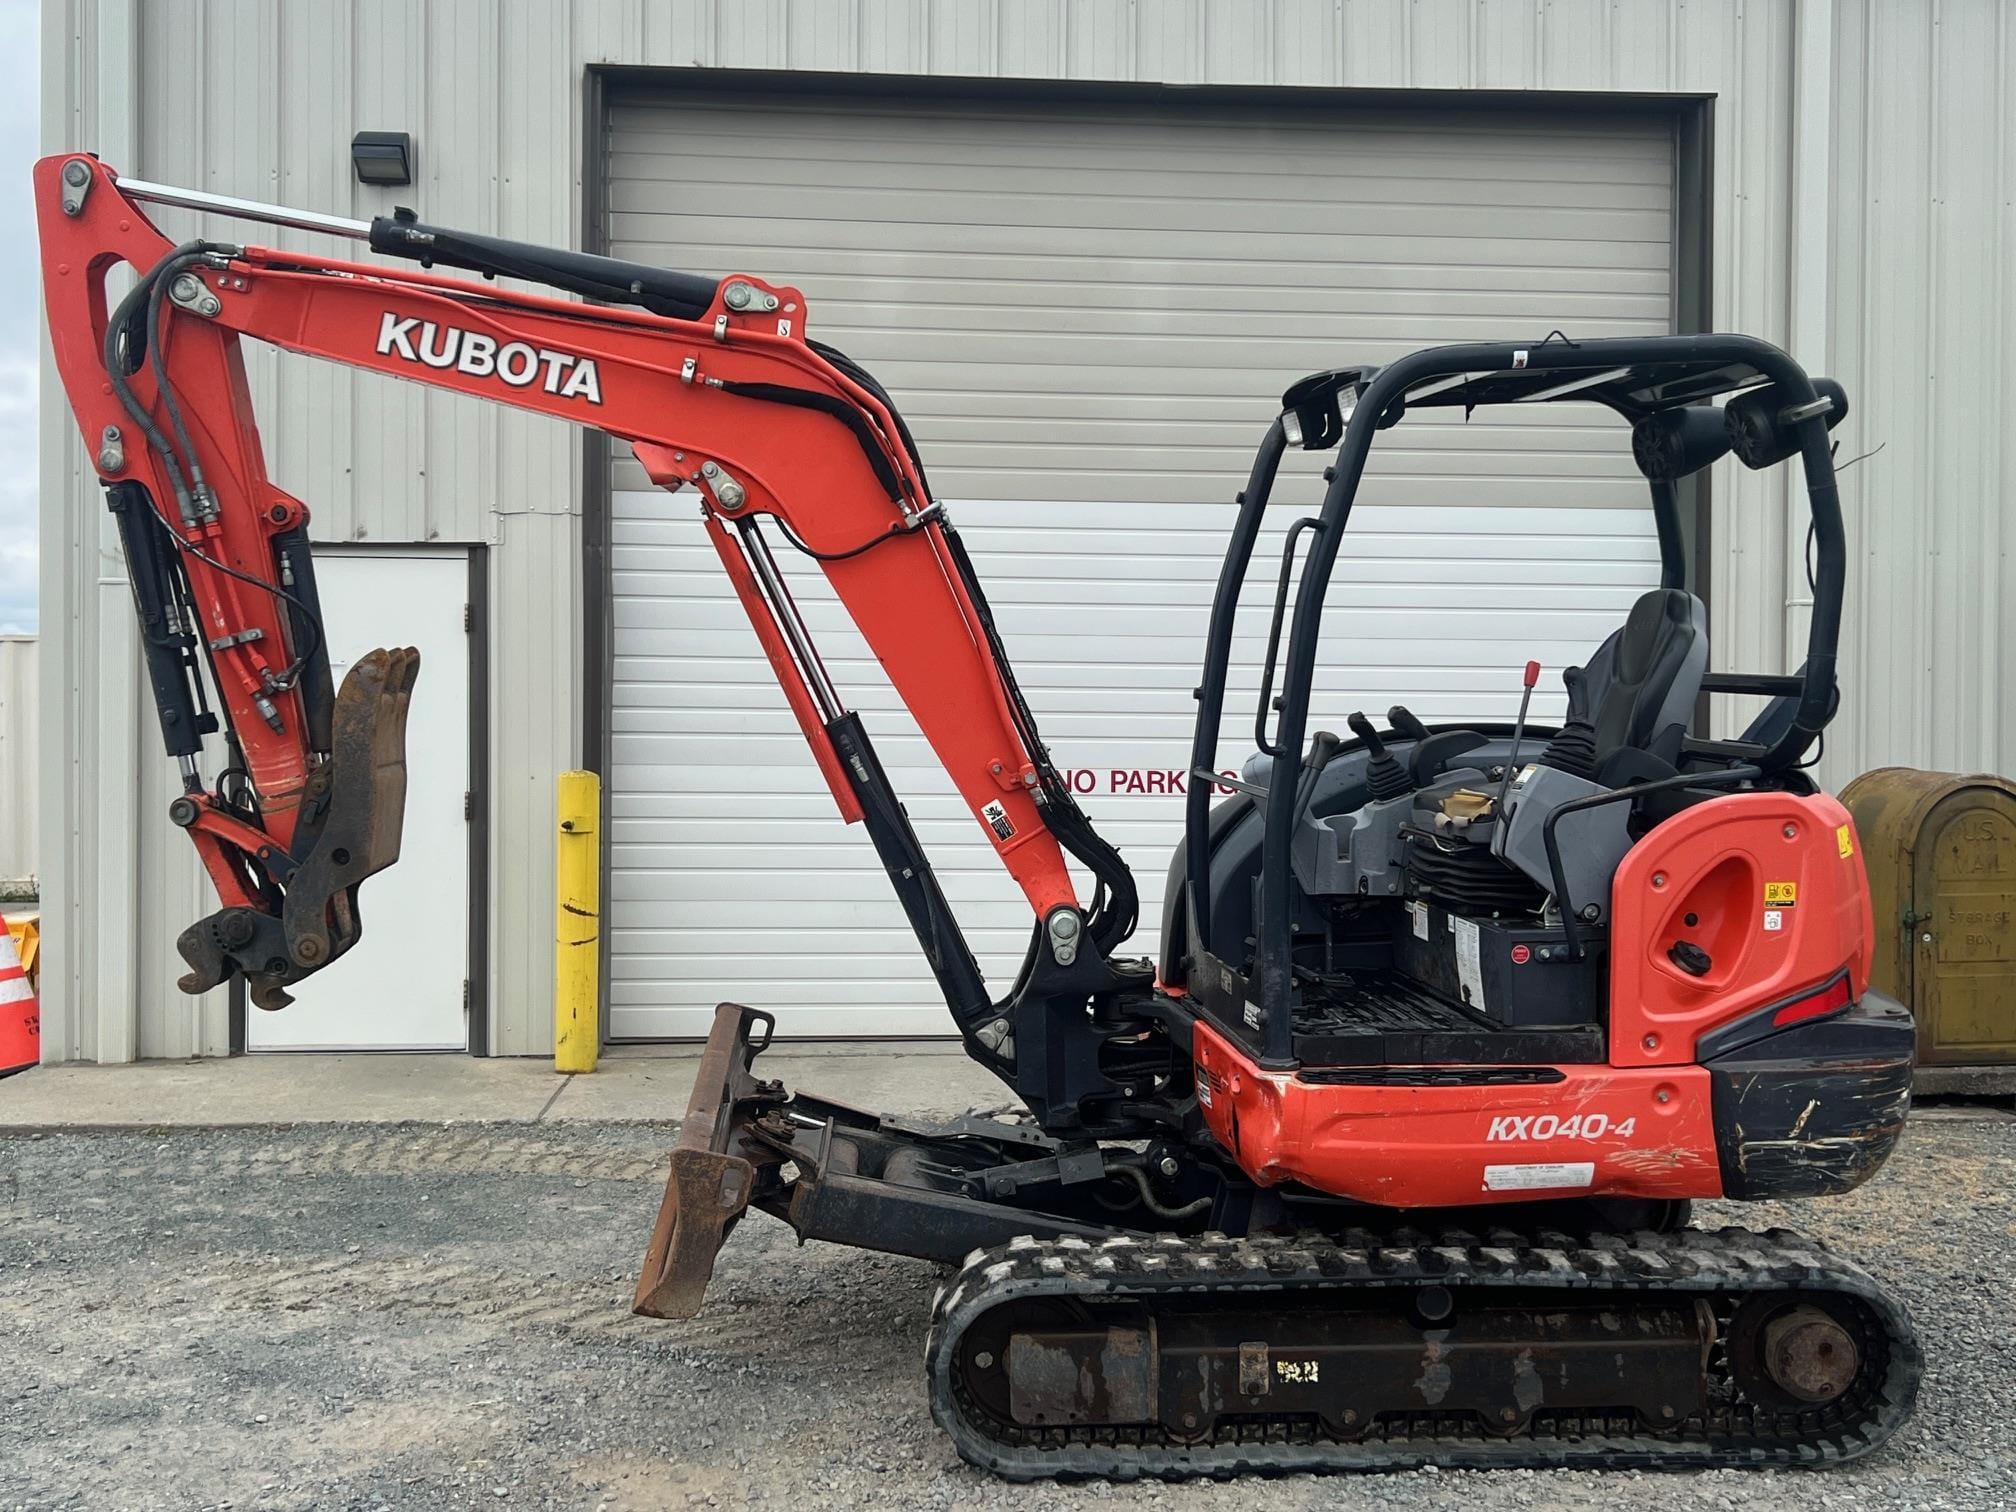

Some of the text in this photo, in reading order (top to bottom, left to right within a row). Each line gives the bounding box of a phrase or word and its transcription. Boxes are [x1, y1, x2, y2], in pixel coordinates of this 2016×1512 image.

[376, 311, 602, 405] KUBOTA
[1055, 769, 1238, 795] NO PARKG
[1948, 911, 2011, 924] STORAGE
[1965, 934, 1994, 947] BOX
[1486, 1113, 1636, 1141] KX040-4
